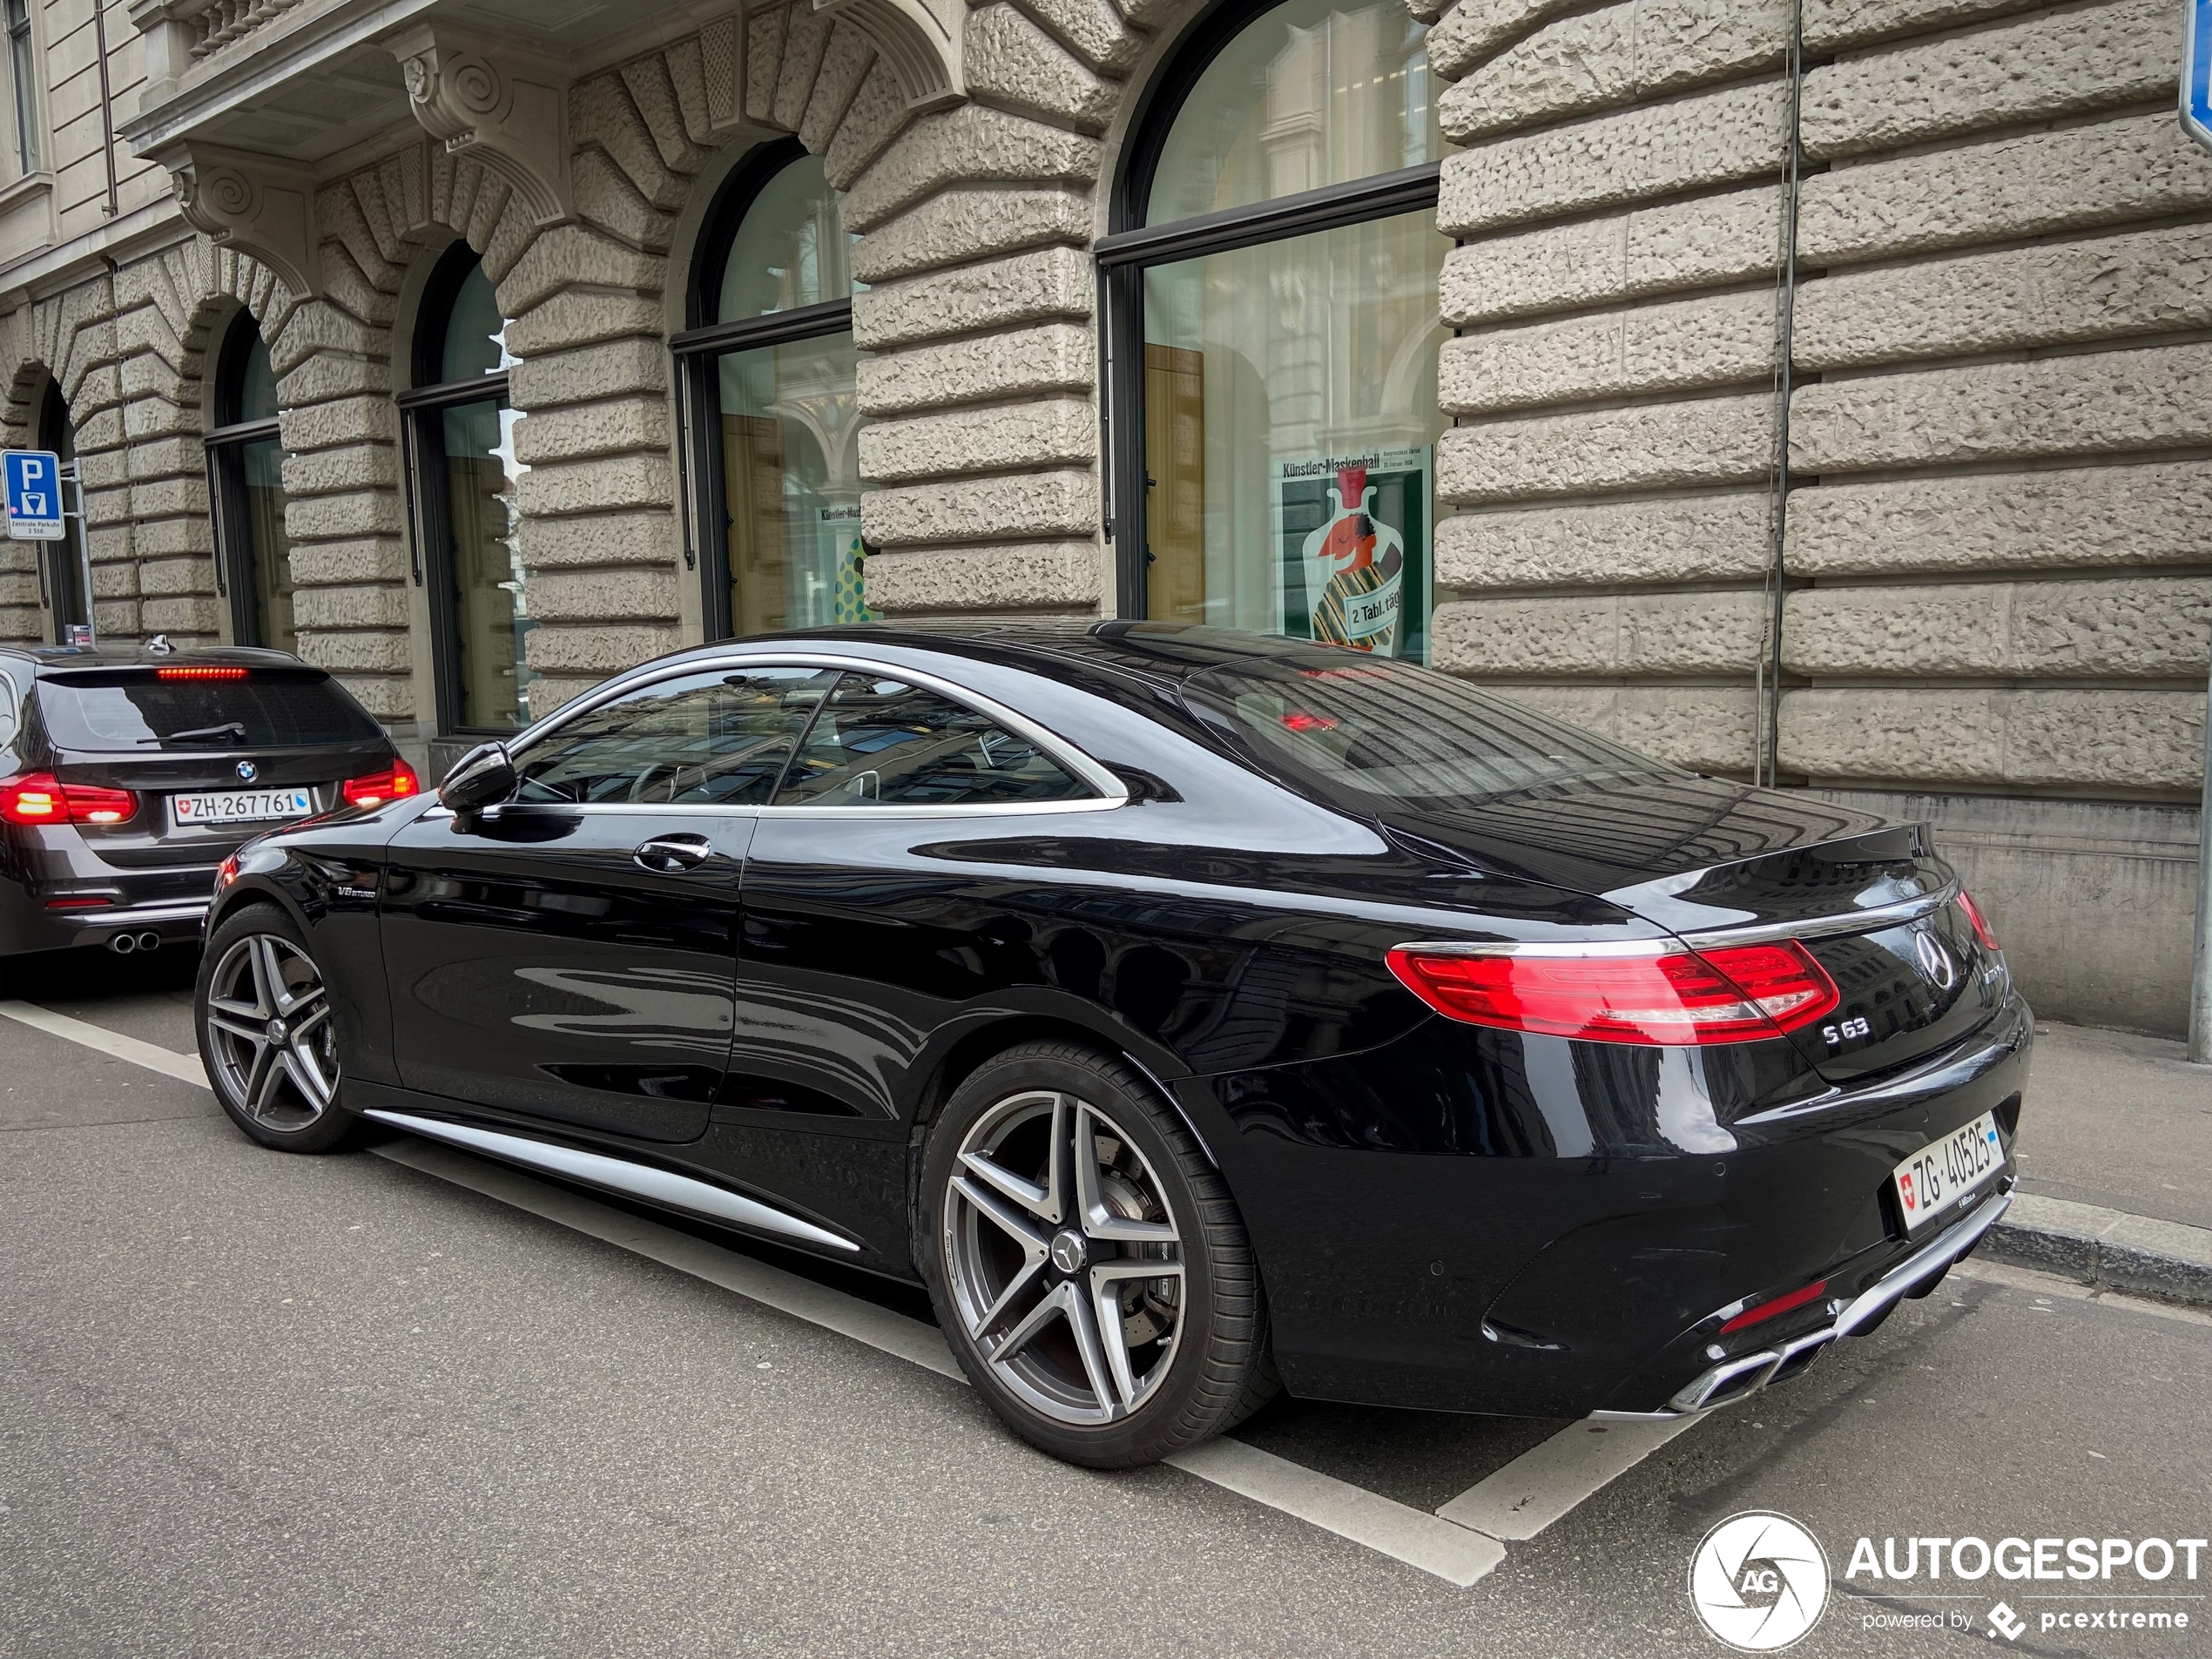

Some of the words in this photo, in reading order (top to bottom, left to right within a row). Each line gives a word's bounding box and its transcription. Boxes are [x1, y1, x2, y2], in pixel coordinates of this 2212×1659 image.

[21, 459, 43, 490] P
[1283, 453, 1379, 478] Künstler-Maskenball
[1352, 610, 1359, 624] 2
[1360, 600, 1386, 621] Tabl.
[1823, 1025, 1840, 1045] S
[1841, 1017, 1870, 1039] 63
